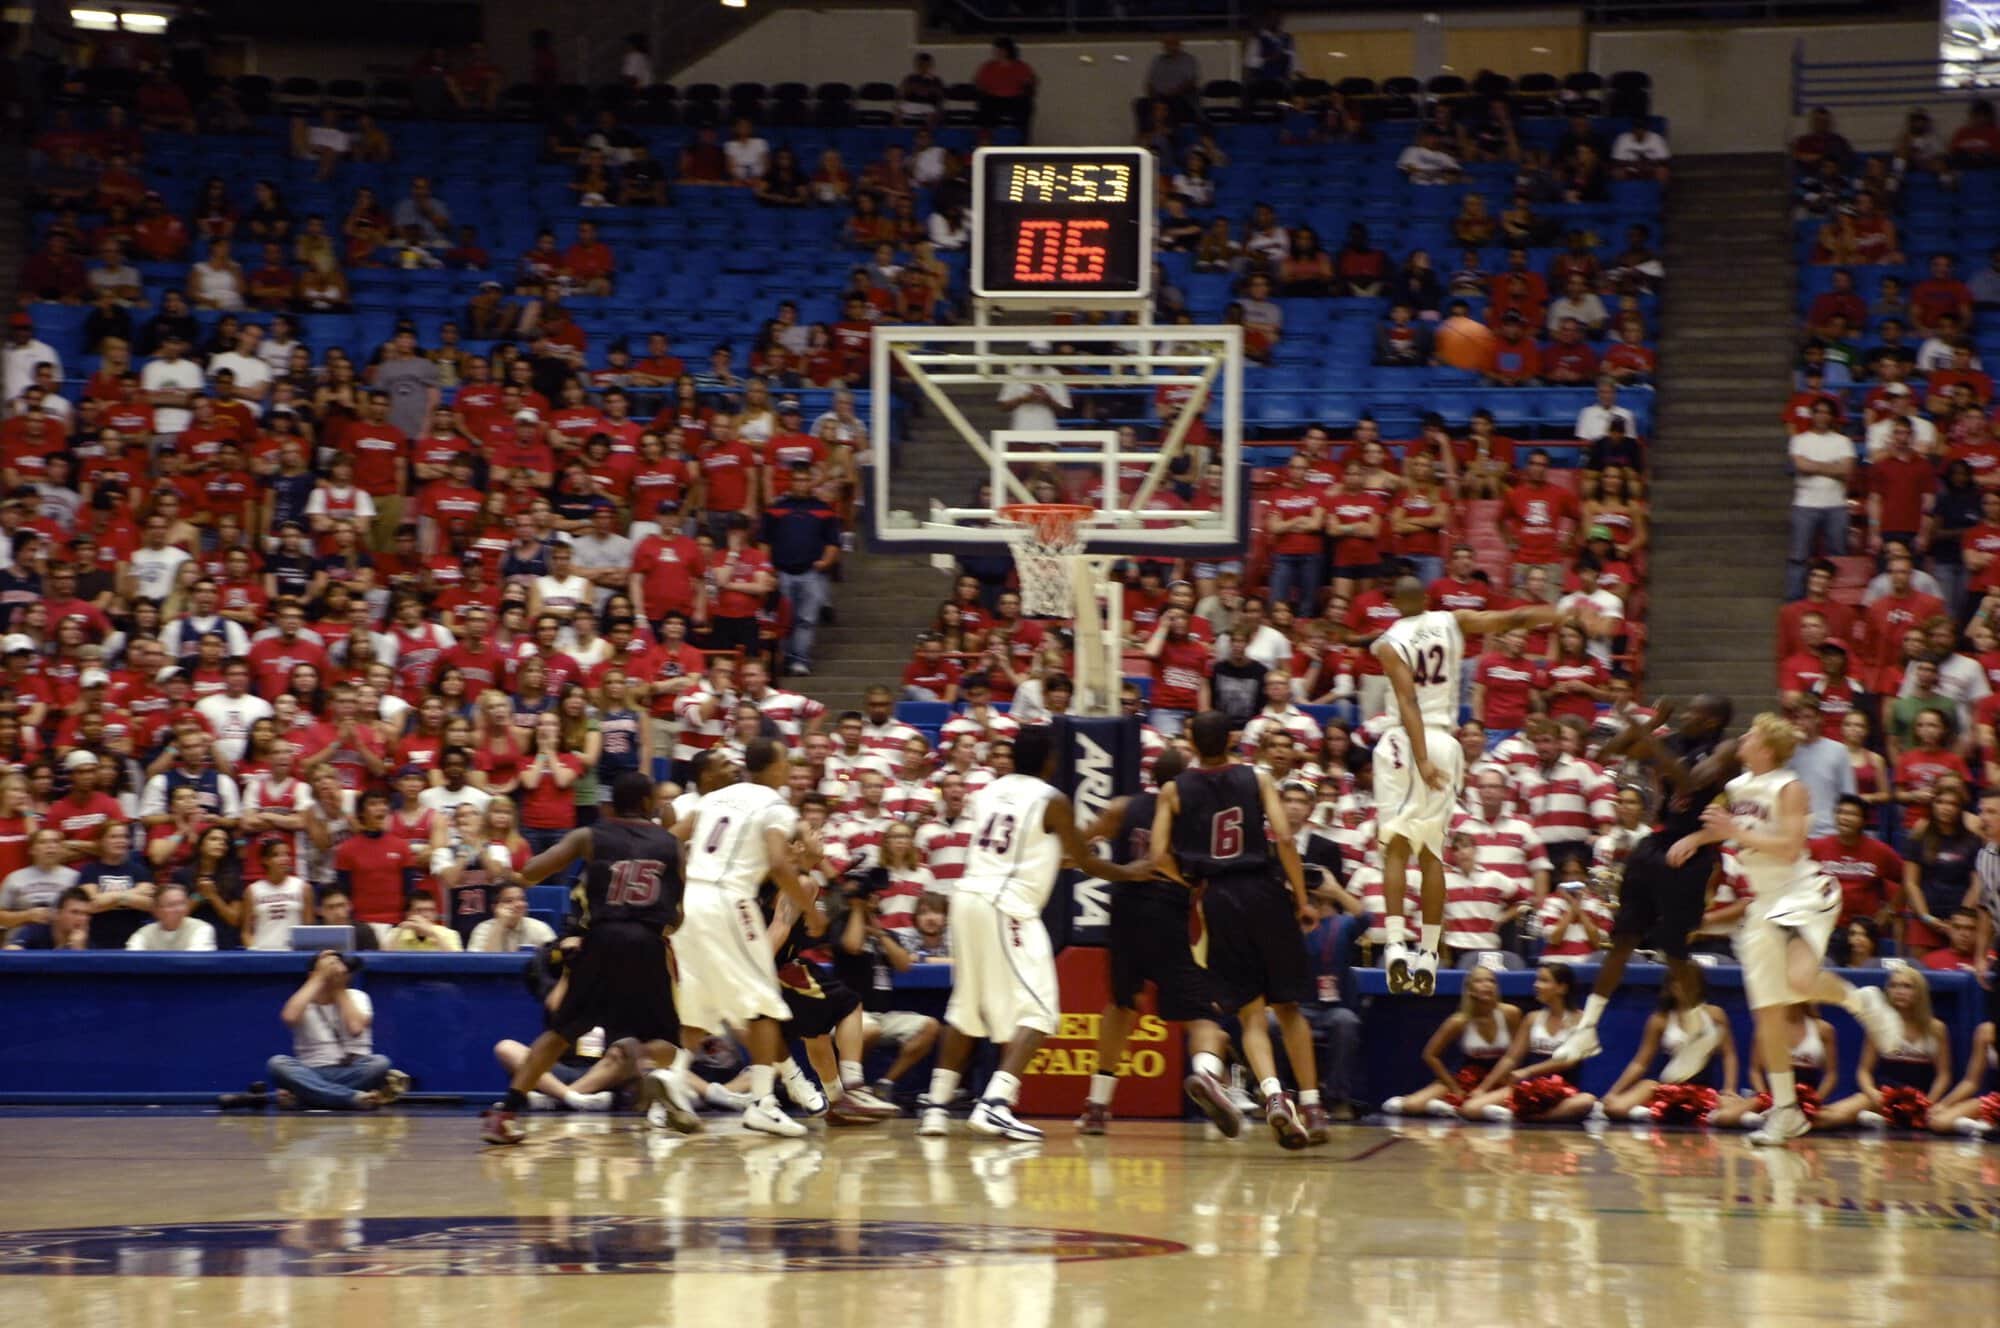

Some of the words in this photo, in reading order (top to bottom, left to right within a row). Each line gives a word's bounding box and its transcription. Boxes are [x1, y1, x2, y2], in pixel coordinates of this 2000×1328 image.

[1009, 164, 1130, 202] 14:53
[1014, 220, 1109, 283] 06
[1413, 645, 1446, 686] 42
[703, 815, 731, 854] 0
[978, 812, 1016, 854] 43
[1210, 806, 1244, 859] 6
[607, 858, 666, 907] 15
[1056, 1013, 1169, 1042] ELS
